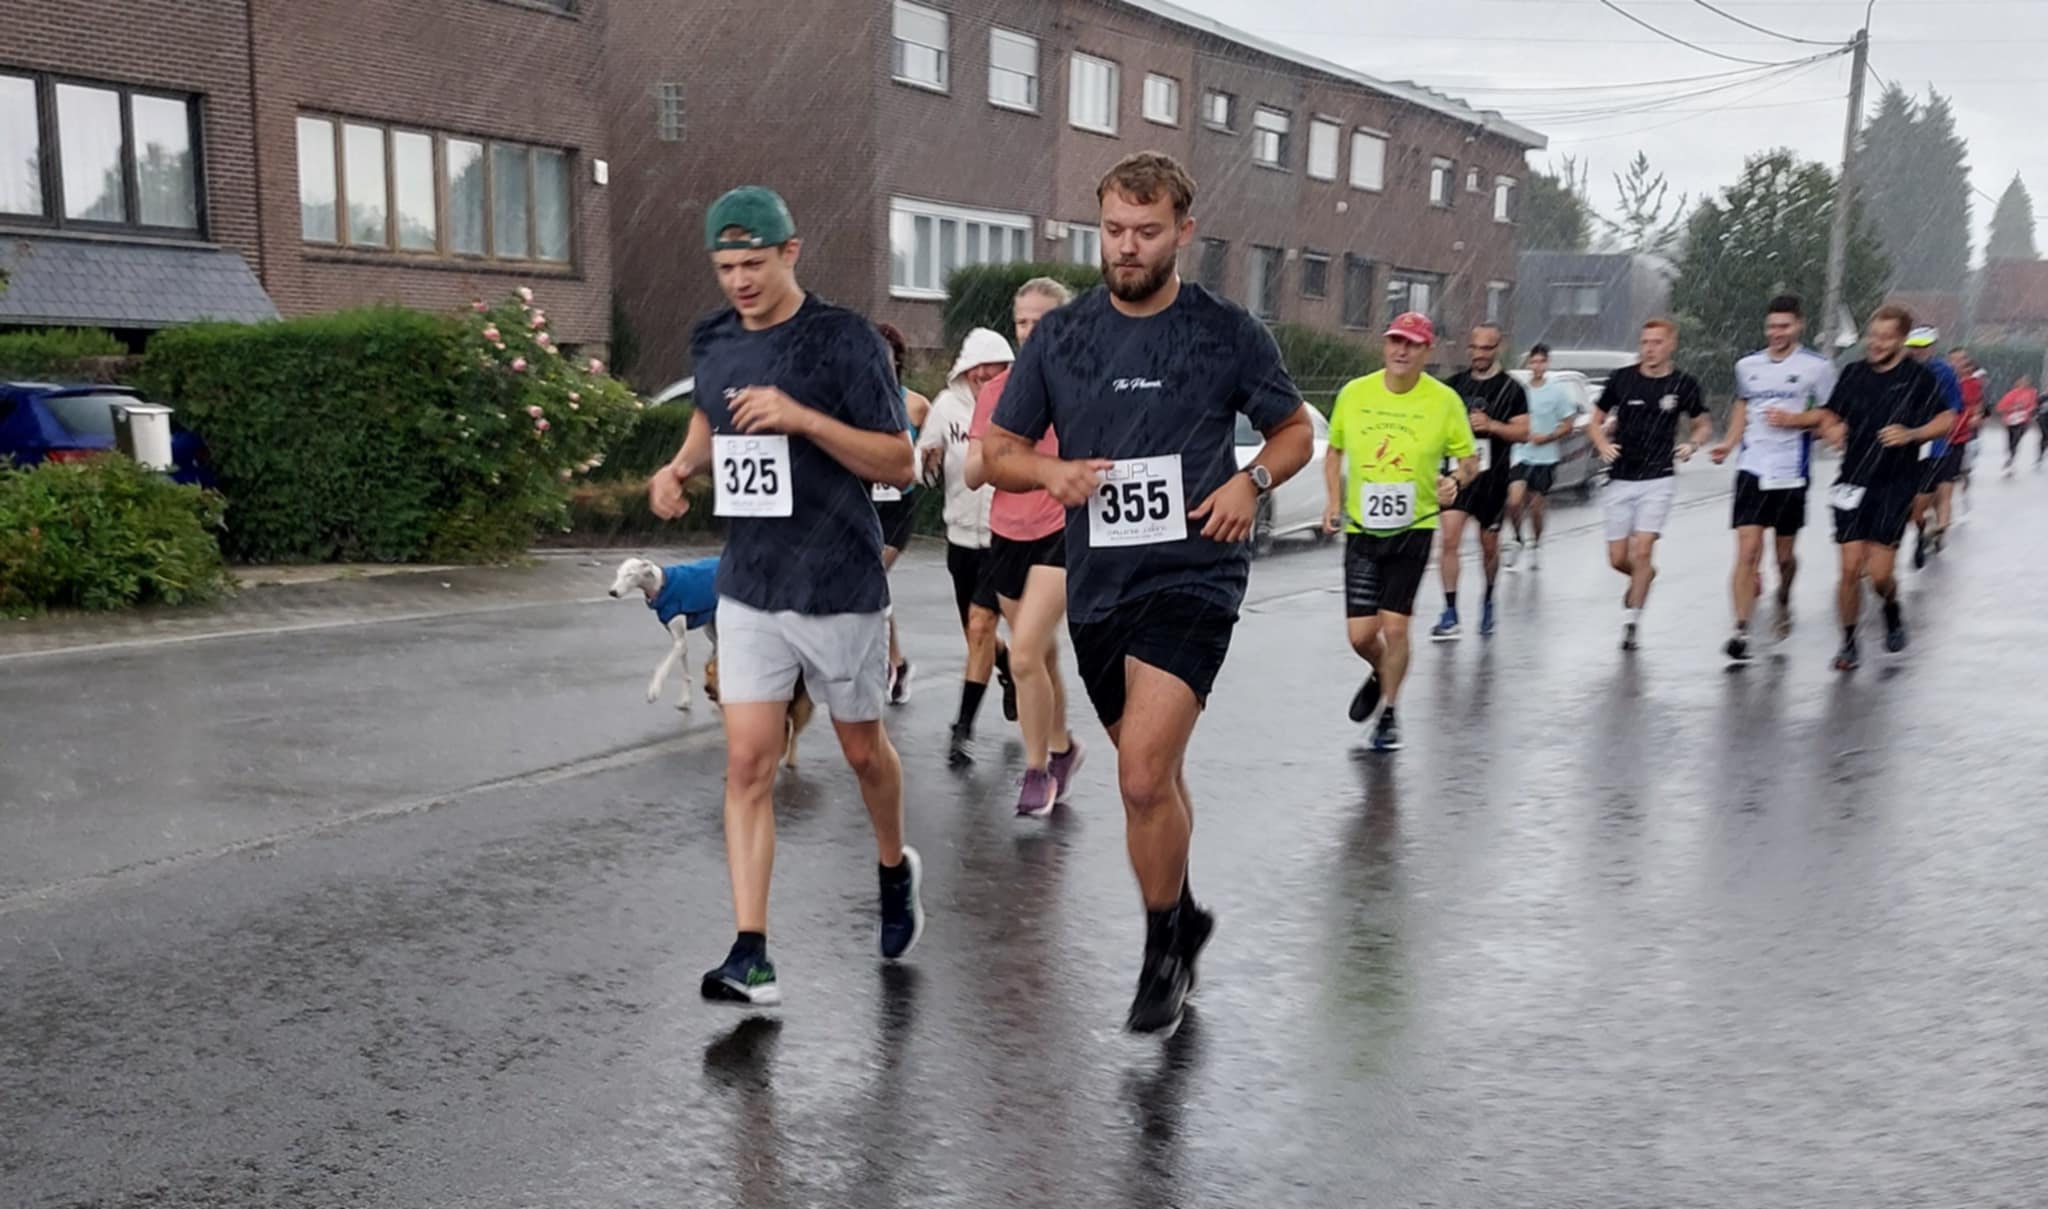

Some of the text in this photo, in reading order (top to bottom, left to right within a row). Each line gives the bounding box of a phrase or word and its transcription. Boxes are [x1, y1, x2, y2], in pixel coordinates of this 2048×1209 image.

[724, 458, 778, 495] 325
[1100, 480, 1170, 524] 355
[1368, 495, 1407, 516] 265
